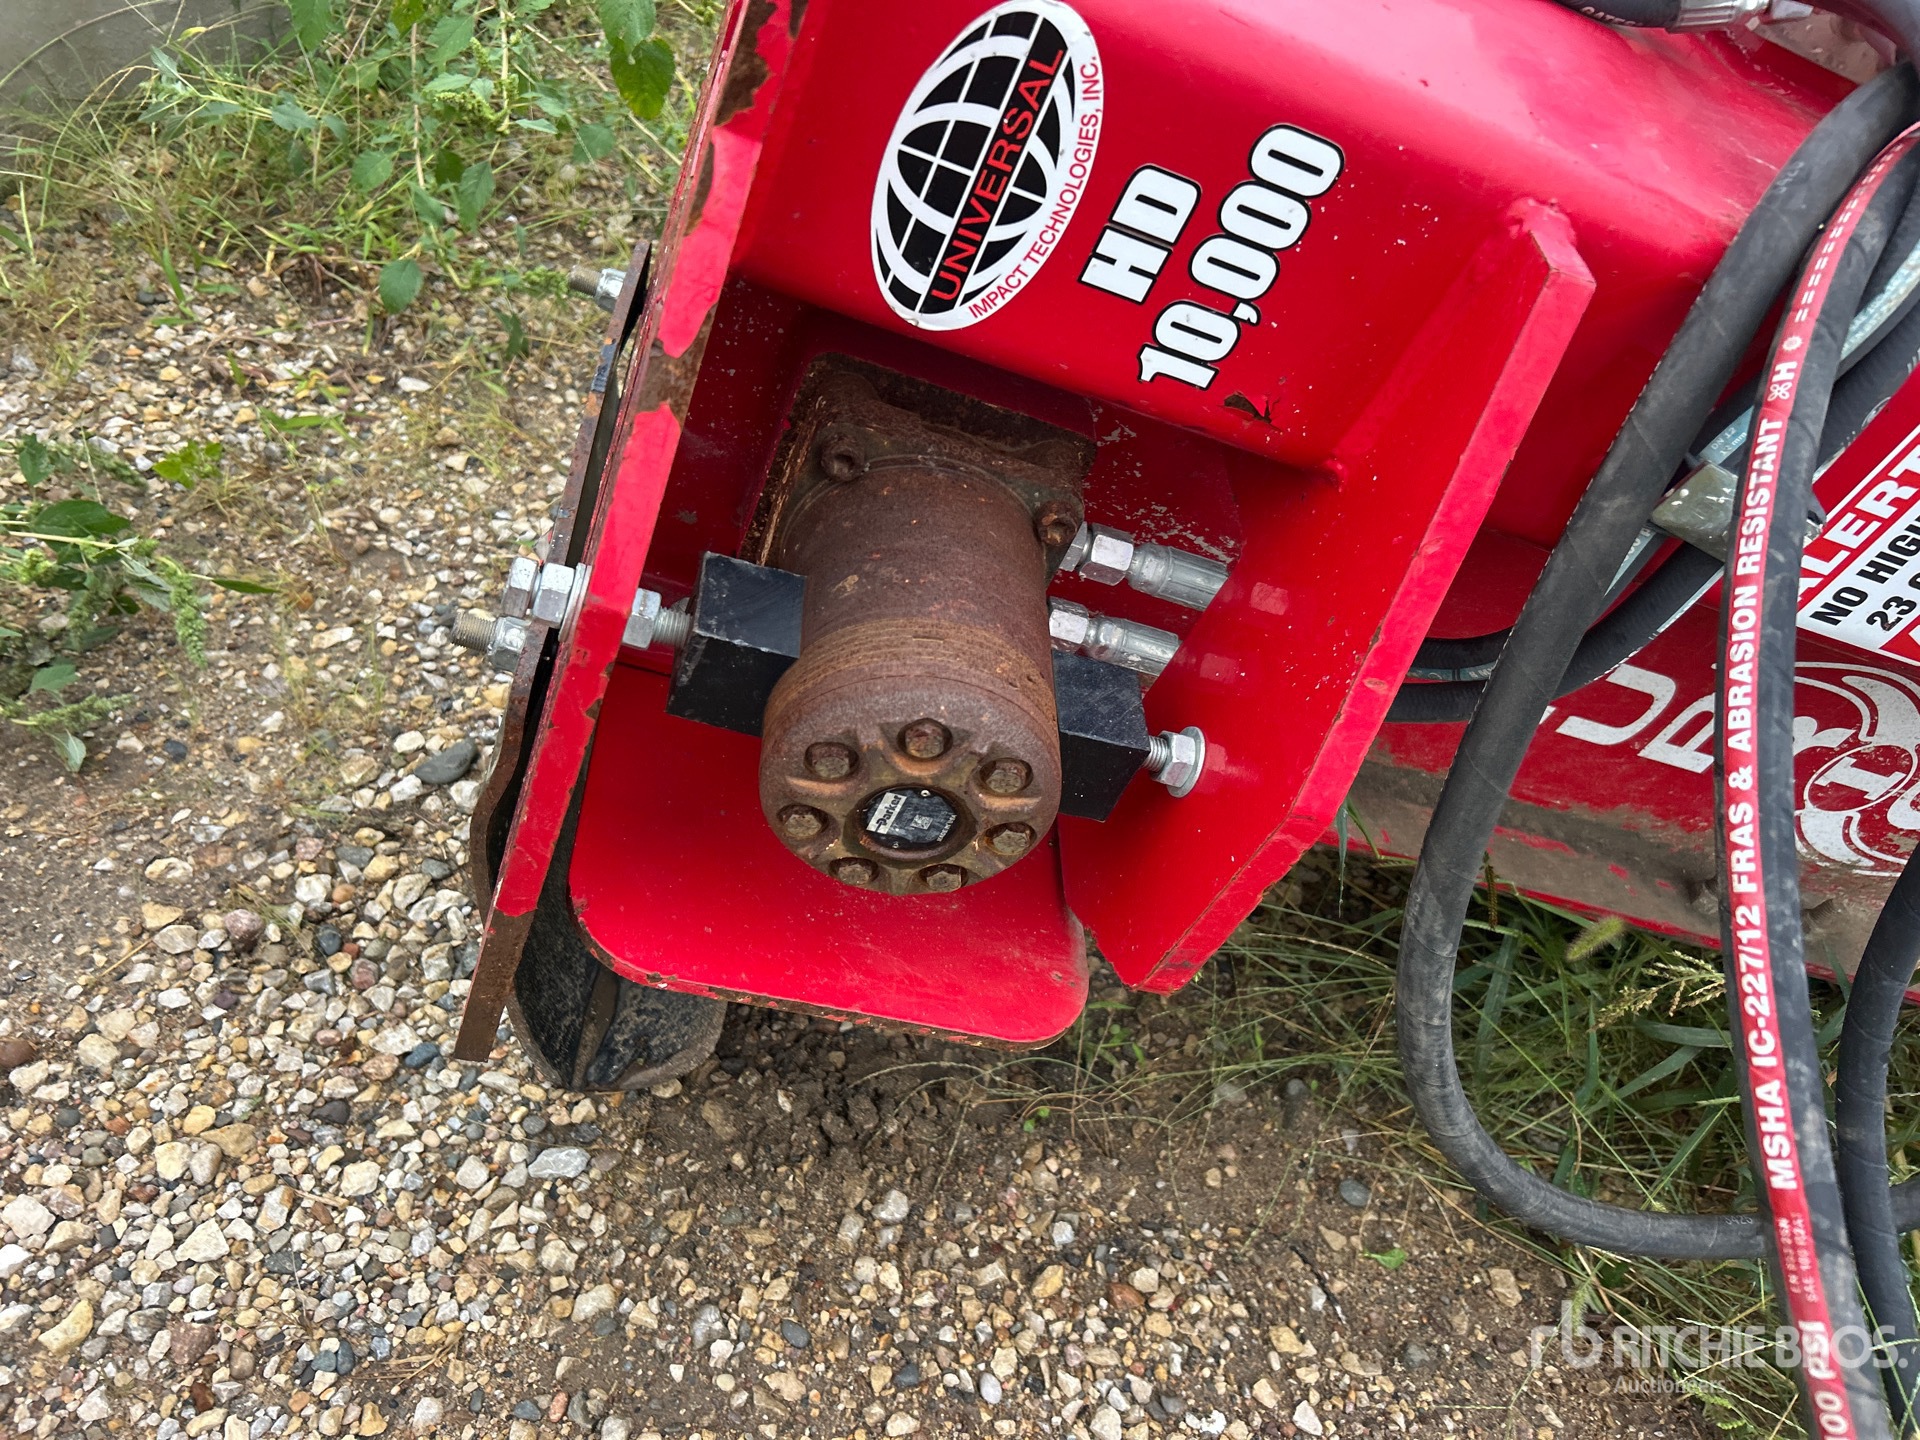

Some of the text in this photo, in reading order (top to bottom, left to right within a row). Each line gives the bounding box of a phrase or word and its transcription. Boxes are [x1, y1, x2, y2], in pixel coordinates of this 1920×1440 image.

[931, 49, 1064, 301] UNIVERSAL
[969, 56, 1102, 319] IMPACT TECHNOLOGIES, INC.
[1079, 164, 1202, 302] HD
[1138, 124, 1345, 388] 10,000
[1809, 586, 1868, 626] NO
[1866, 595, 1917, 632] 23
[876, 795, 902, 830] Parker
[1728, 419, 1798, 1190] MSHA IC-227/12 FRAS & ABRASION RESISTANT
[1814, 1391, 1850, 1440] 00
